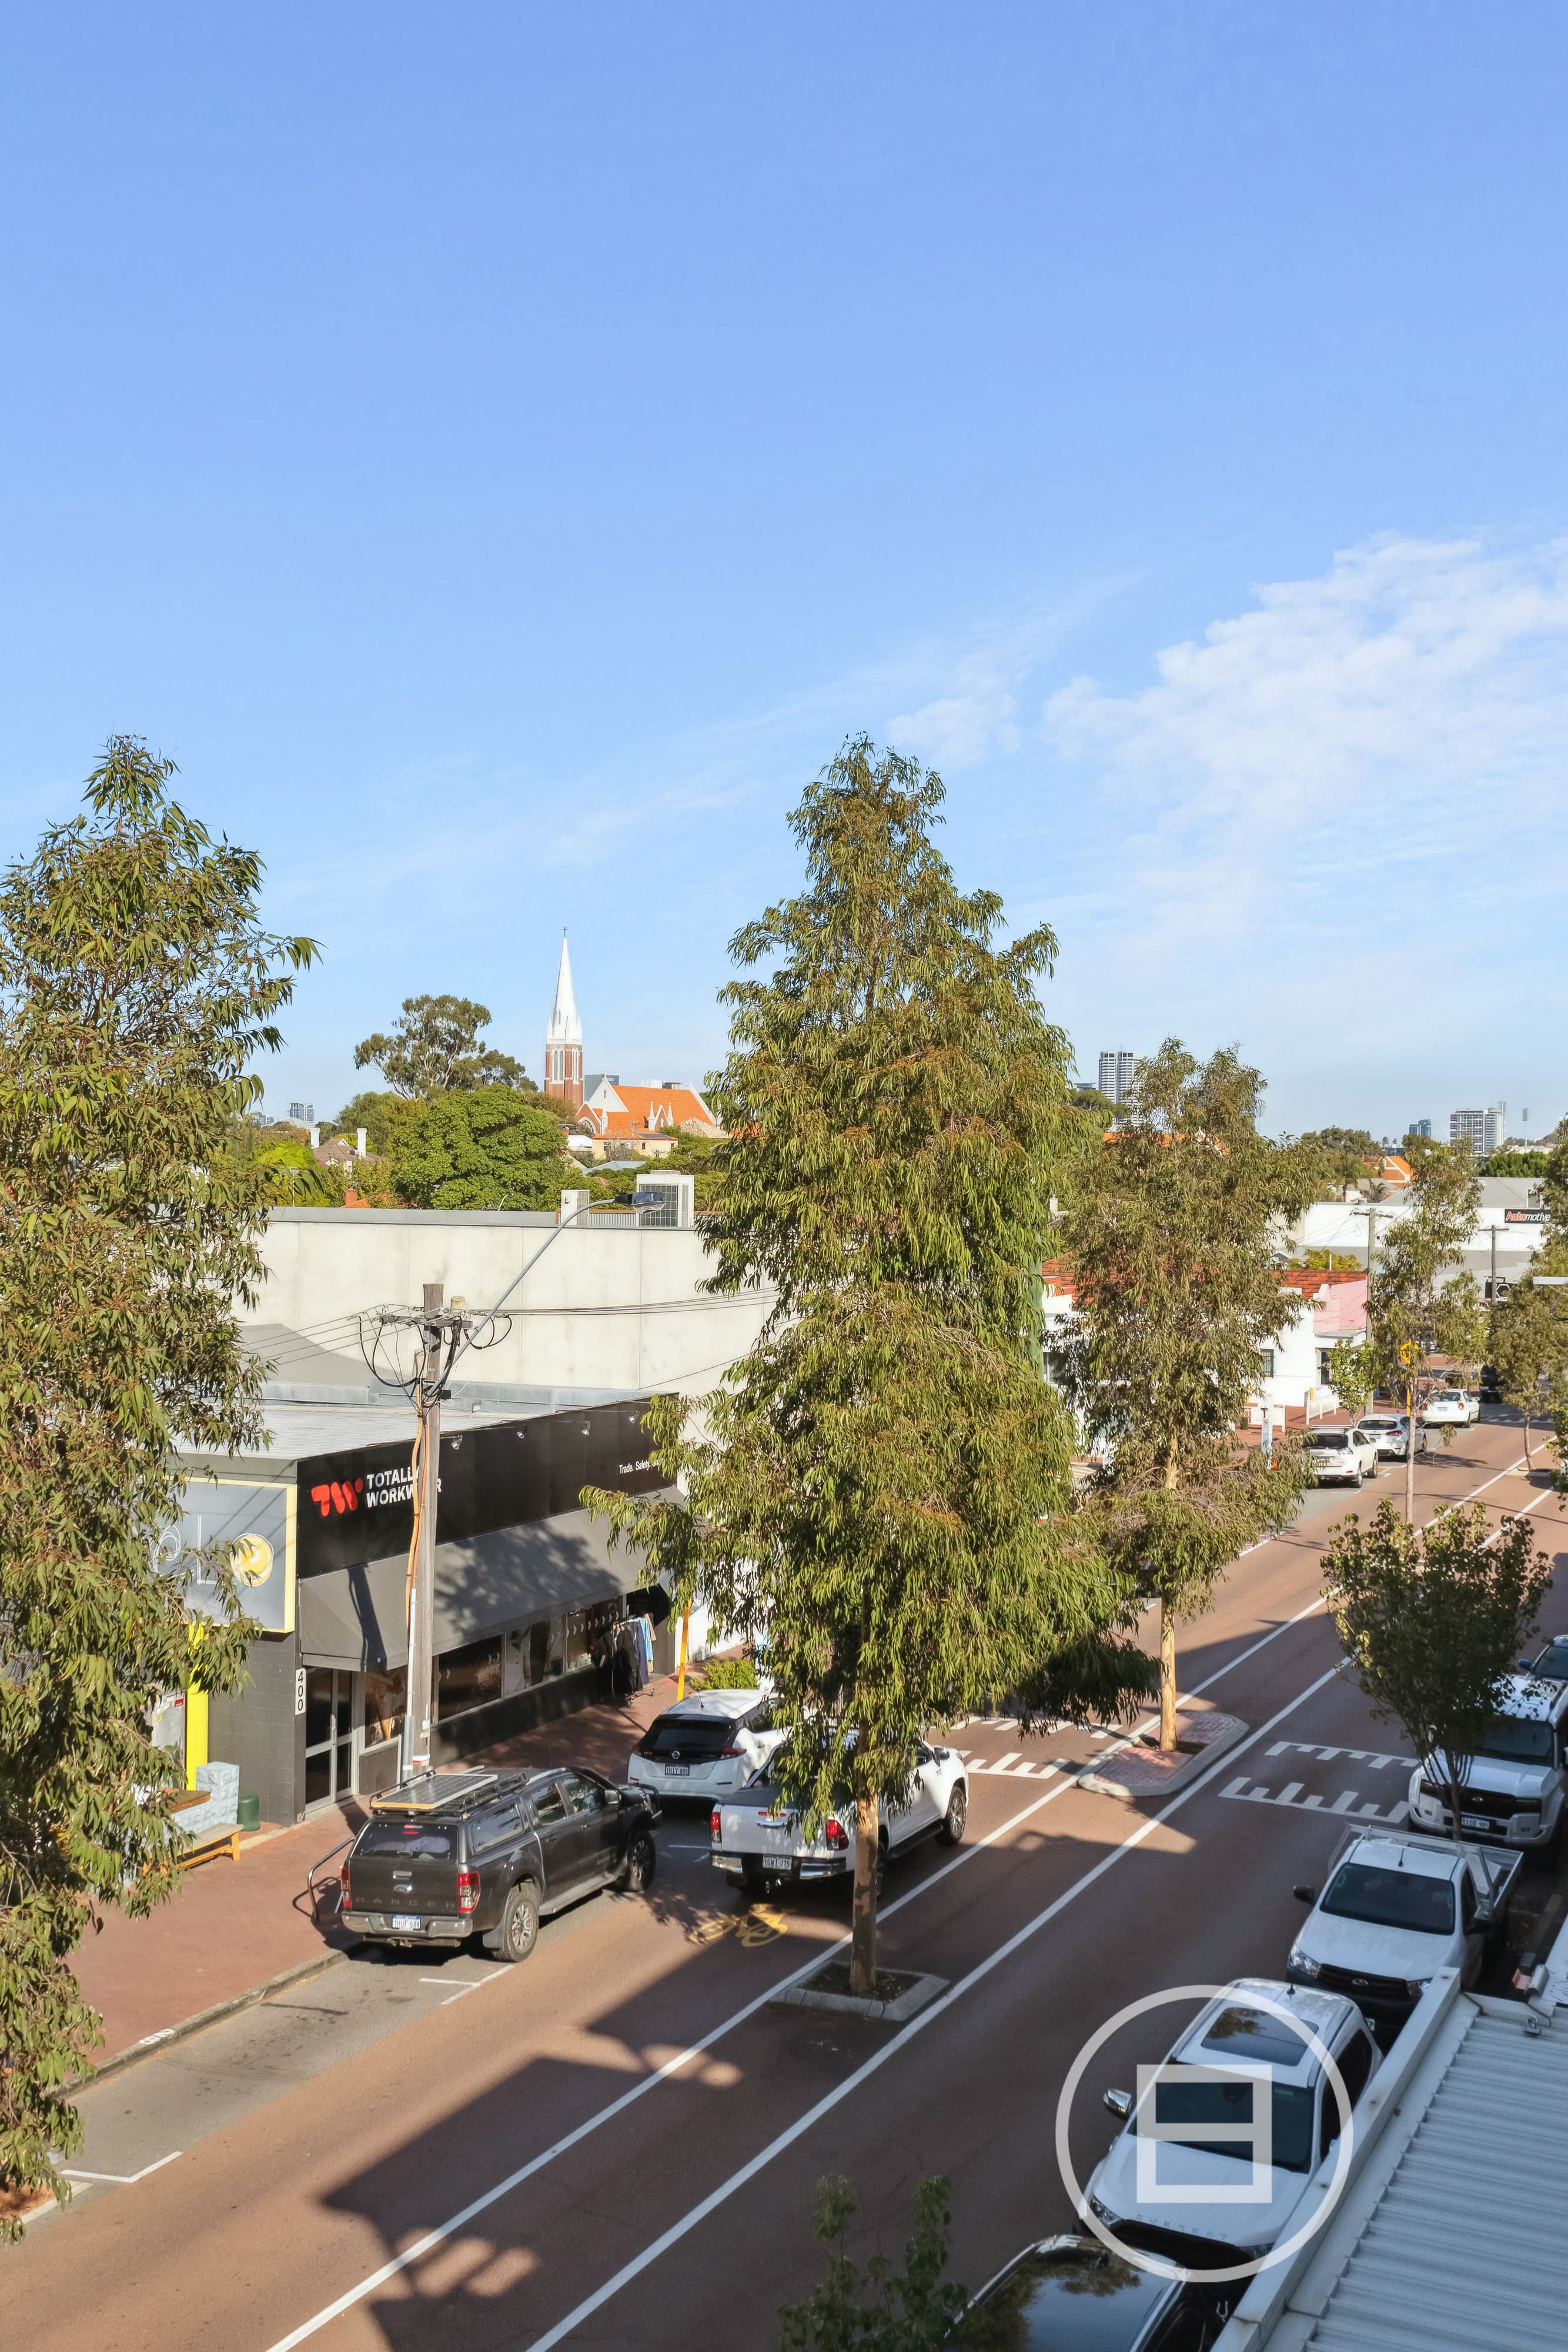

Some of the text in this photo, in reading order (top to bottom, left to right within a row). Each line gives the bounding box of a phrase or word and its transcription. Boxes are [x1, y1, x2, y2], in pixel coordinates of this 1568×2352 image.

[1506, 1211, 1551, 1221] Automotive
[618, 1462, 634, 1474] Trade.
[636, 1459, 651, 1471] Safety.
[366, 1478, 442, 1508] WORKWR
